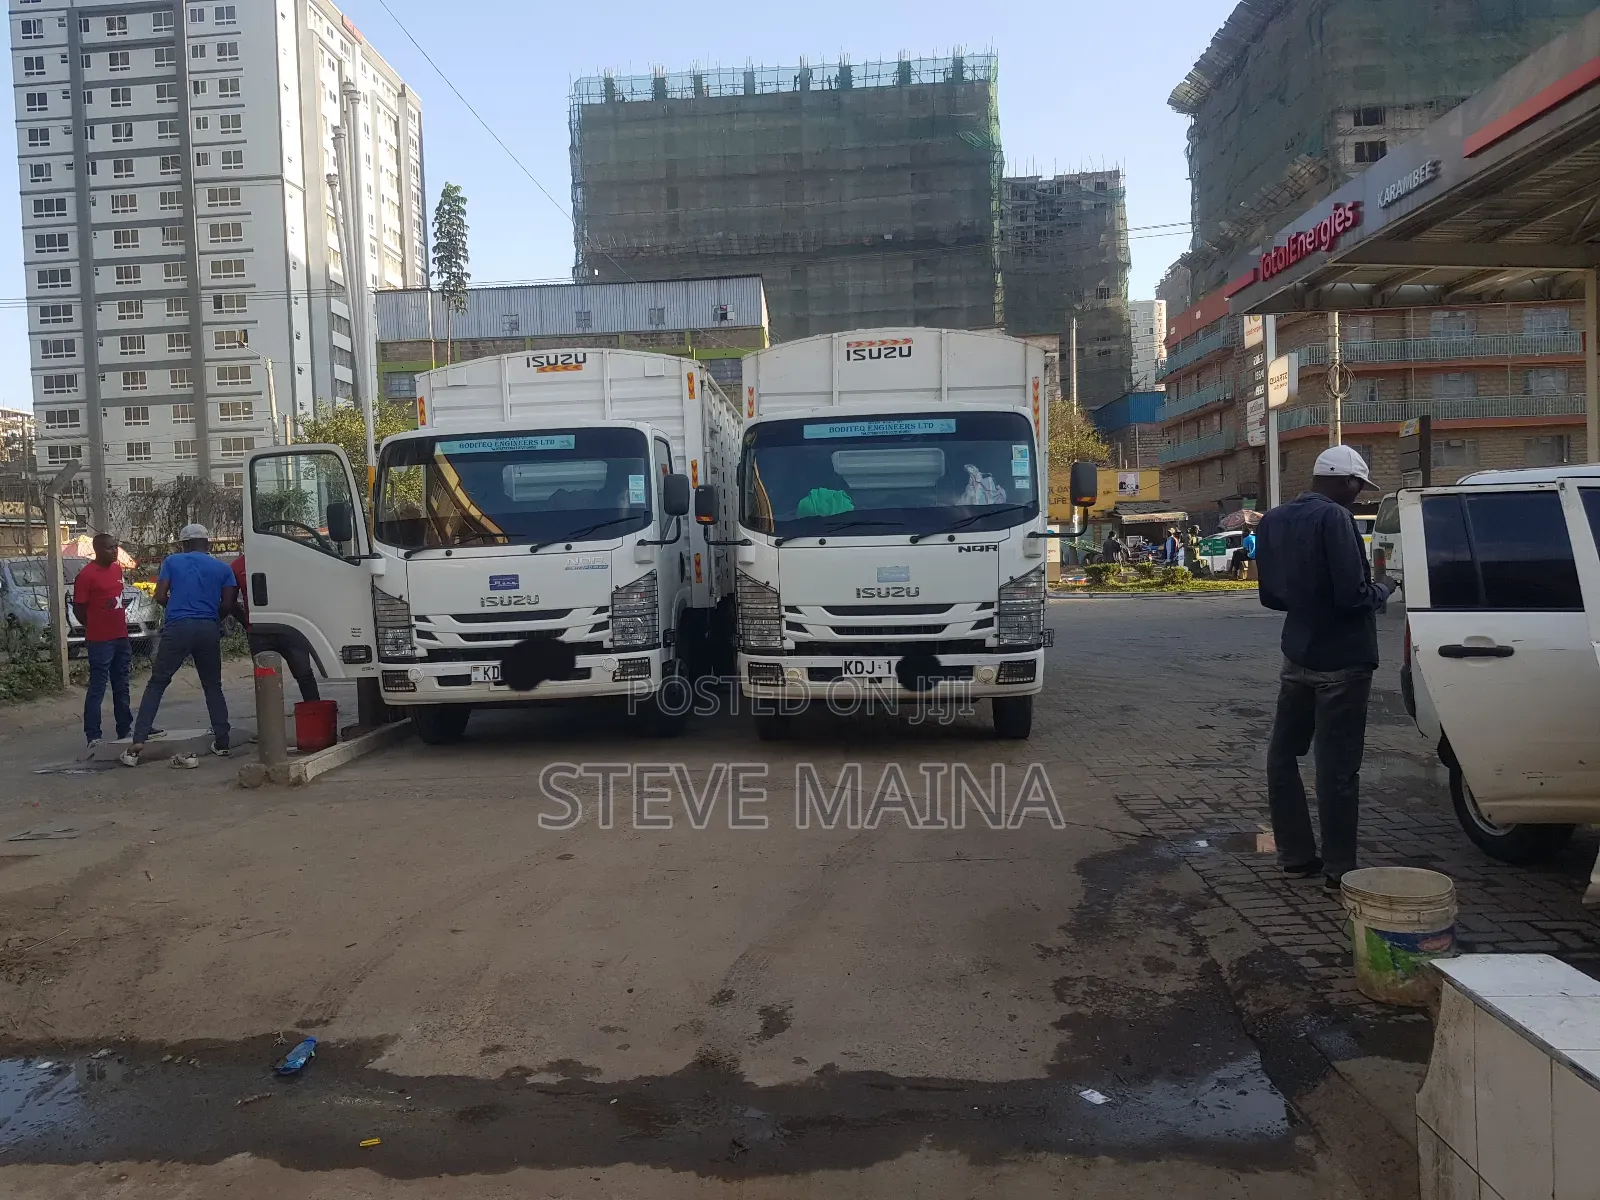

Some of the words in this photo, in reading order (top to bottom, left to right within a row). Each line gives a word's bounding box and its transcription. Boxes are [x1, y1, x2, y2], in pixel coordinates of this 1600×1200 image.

[1259, 202, 1360, 281] TotalEnergies
[526, 352, 587, 368] ISUZU
[846, 345, 912, 361] ISUZU
[1269, 371, 1288, 385] QUARTZ
[829, 425, 866, 434] BODITEQ
[867, 422, 916, 432] ENGINEERS
[918, 422, 934, 430] LTD
[459, 441, 493, 449] BODITEQ
[494, 438, 539, 448] ENGINEERS
[958, 544, 998, 553] NQR
[856, 586, 920, 599] ISUZU
[480, 594, 540, 608] ISUZU
[483, 665, 500, 680] KD
[844, 660, 875, 675] KDJ
